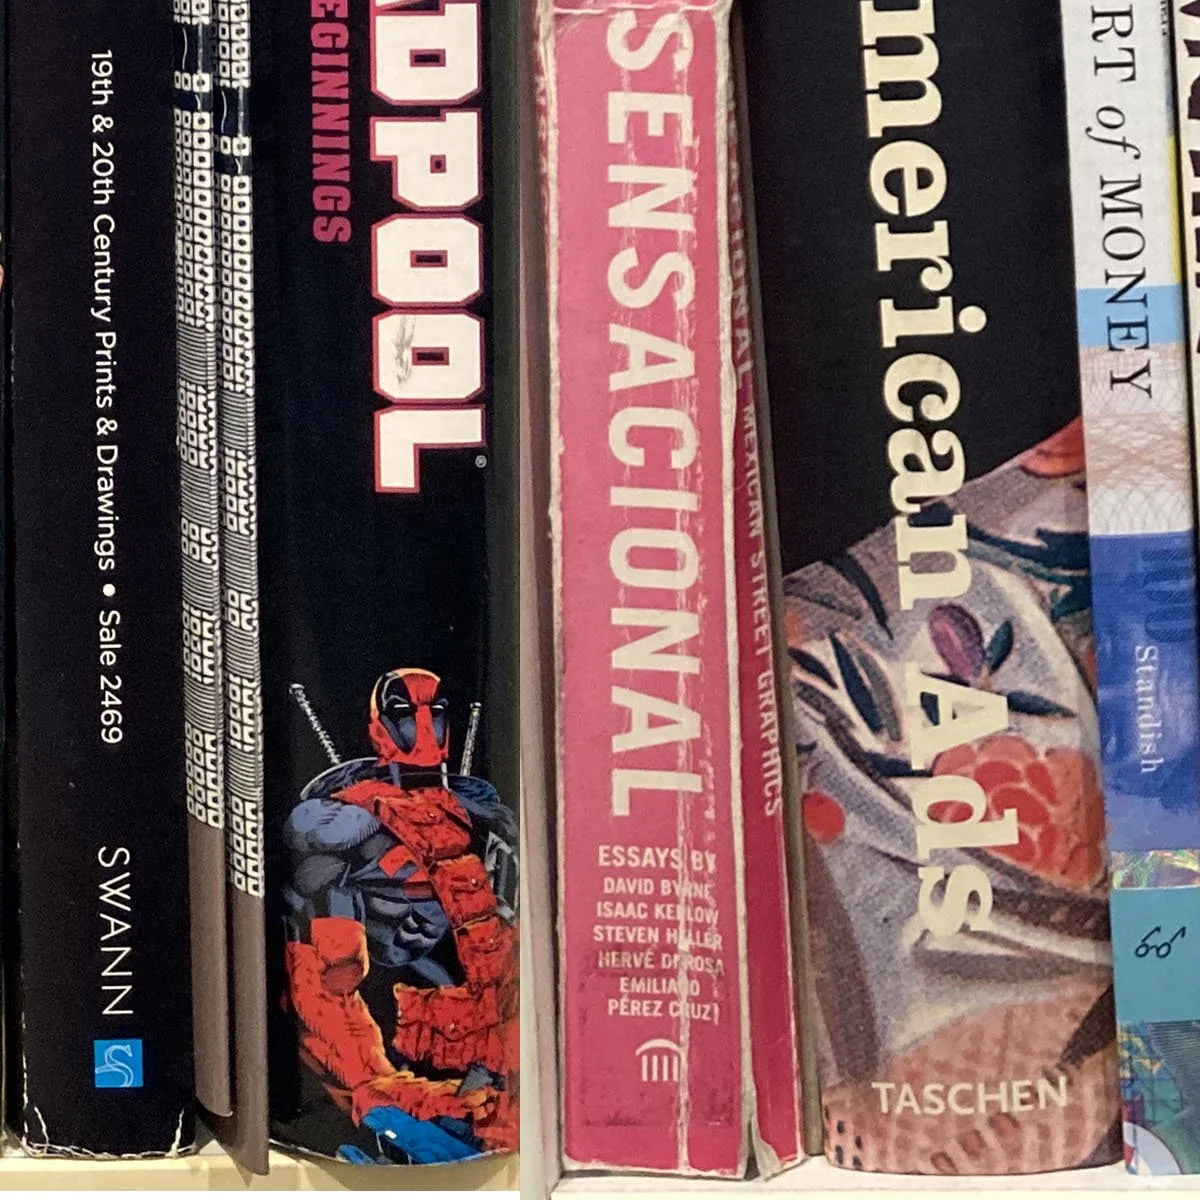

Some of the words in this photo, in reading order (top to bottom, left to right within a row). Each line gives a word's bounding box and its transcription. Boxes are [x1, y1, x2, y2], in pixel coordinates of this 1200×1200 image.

[91, 49, 114, 105] 19th
[92, 114, 115, 134] &
[1084, 105, 1142, 156] of
[92, 141, 116, 206] 20th
[87, 214, 117, 324] Century
[1099, 174, 1153, 399] MONEY
[94, 333, 118, 409] Prints
[95, 416, 119, 435] &
[606, 9, 704, 818] SENSACIONAL
[89, 443, 121, 573] Drawings
[98, 609, 122, 665] Sale
[100, 675, 124, 745] 2469
[1134, 644, 1165, 774] Standish
[906, 671, 1020, 943] Ads
[598, 845, 683, 871] ESSAYS
[603, 877, 654, 895] DAVID
[97, 847, 135, 1017] SWANN
[593, 925, 659, 944] STEVEN
[597, 901, 648, 919] ISAAC
[608, 994, 664, 1018] PÉREZ
[620, 977, 701, 997] EMILIAO
[871, 1075, 1070, 1117] TASCHEN
